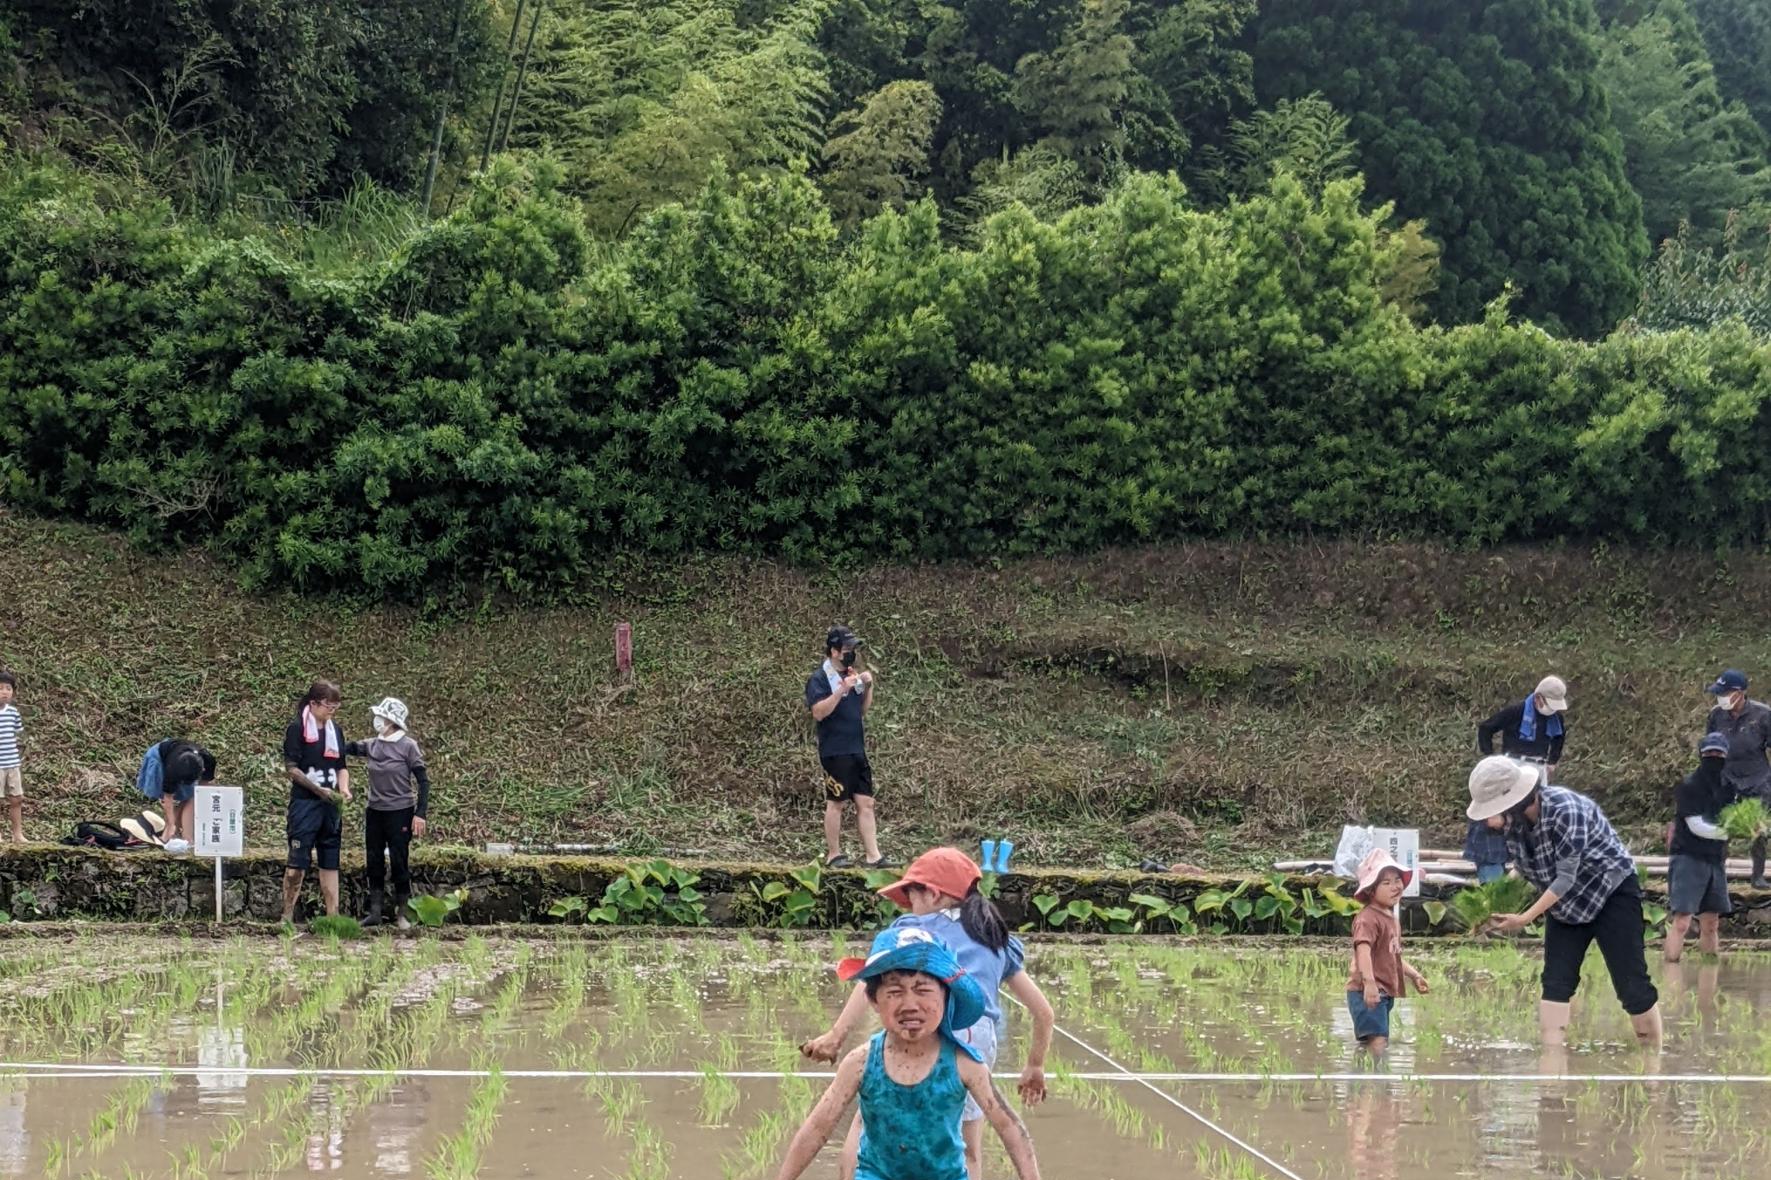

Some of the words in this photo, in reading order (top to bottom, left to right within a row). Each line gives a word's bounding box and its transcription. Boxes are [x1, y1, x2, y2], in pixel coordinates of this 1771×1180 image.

[211, 795, 221, 812] 宮元
[211, 818, 223, 842] ご家族
